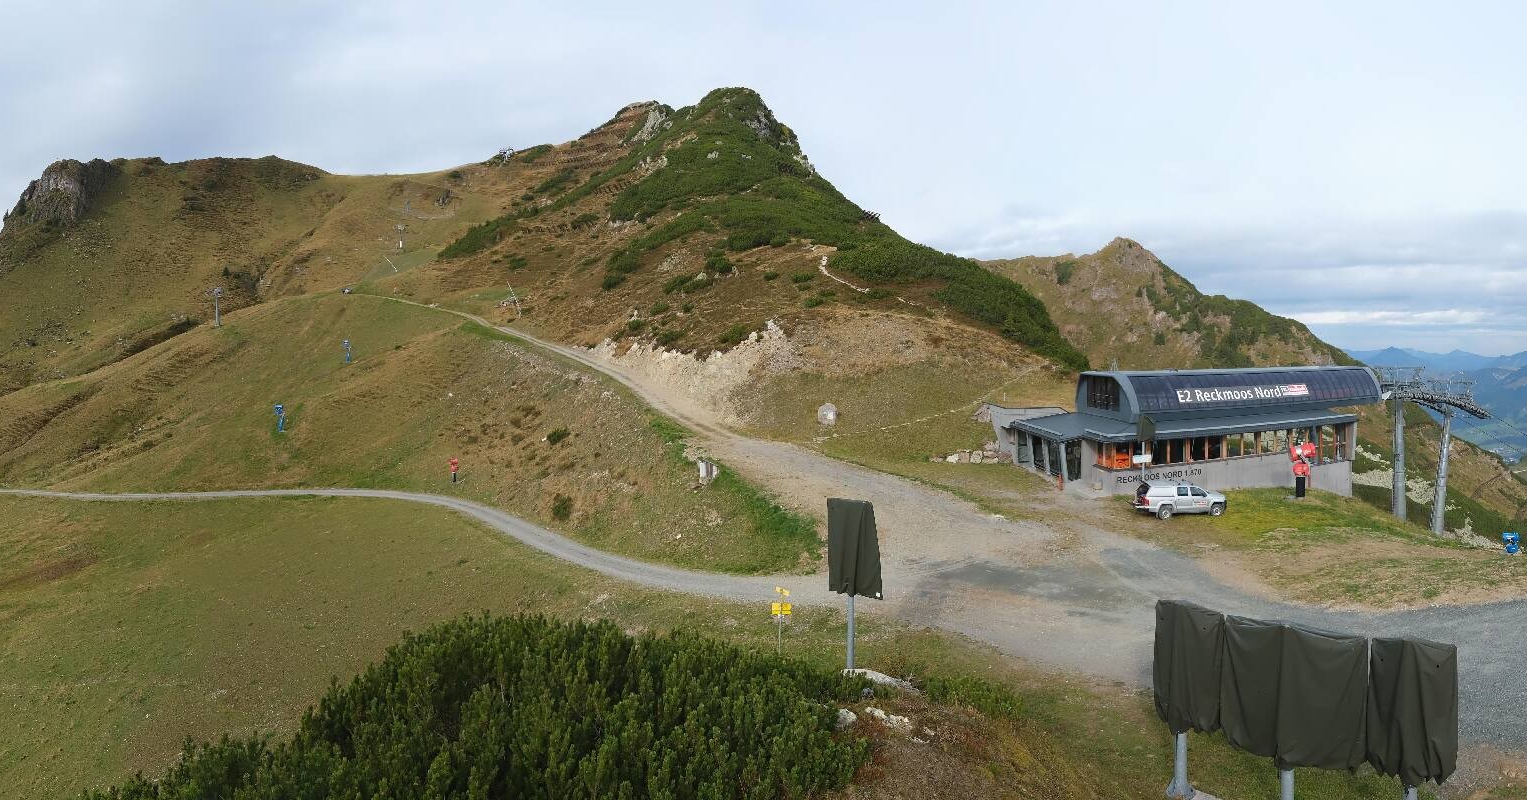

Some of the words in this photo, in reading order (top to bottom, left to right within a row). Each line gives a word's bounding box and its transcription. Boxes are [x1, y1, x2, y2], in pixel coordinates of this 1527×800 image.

[1176, 390, 1193, 402] E2
[1195, 388, 1254, 401] Reckmoos
[1254, 385, 1282, 398] Nord
[1162, 470, 1183, 479] NORD
